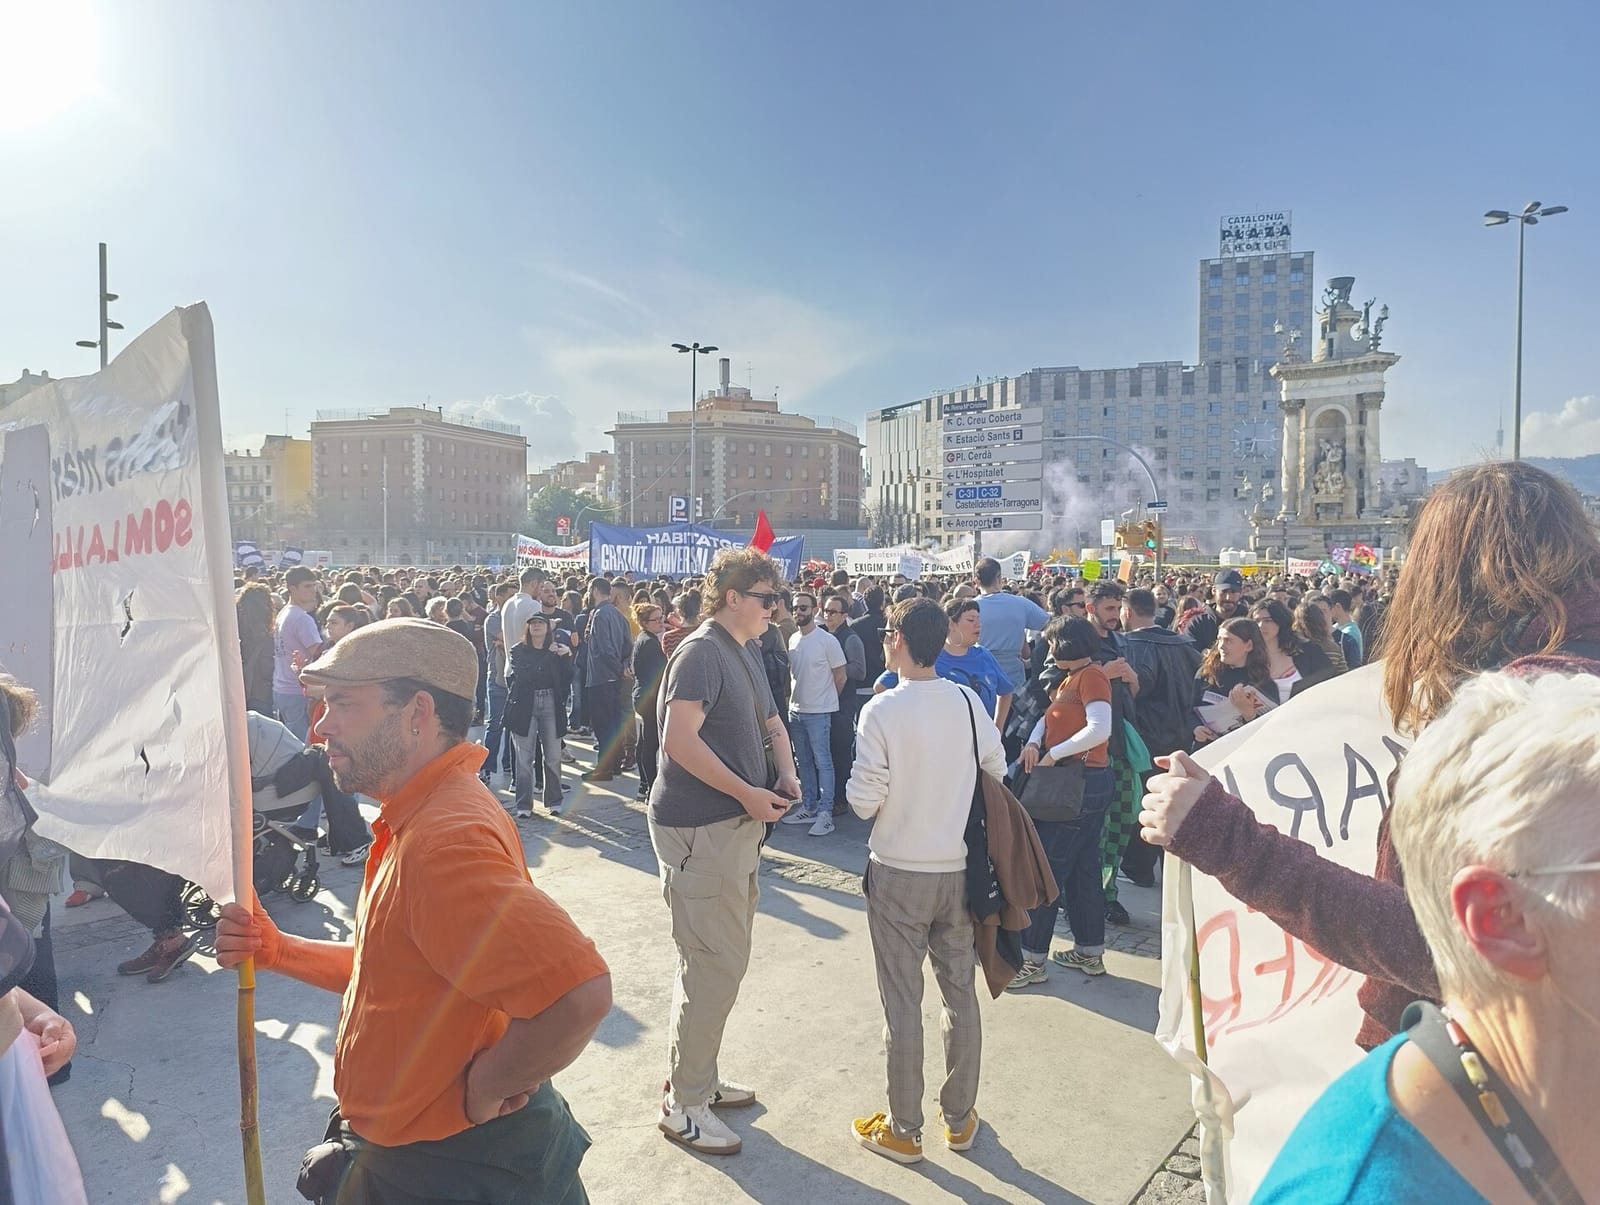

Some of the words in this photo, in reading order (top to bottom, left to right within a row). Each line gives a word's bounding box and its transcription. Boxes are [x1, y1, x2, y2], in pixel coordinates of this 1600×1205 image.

[1228, 213, 1284, 225] CATALONIA
[1221, 225, 1291, 240] PLAZA
[956, 417, 965, 427] C.
[967, 416, 986, 425] Creu
[989, 412, 1022, 424] Coberta
[956, 432, 985, 444] Estació
[987, 431, 1011, 442] Sants
[956, 452, 966, 461] Pl.
[968, 450, 992, 461] Cerdà
[956, 467, 1004, 479] L'Hospitalet
[958, 489, 975, 498] C-31
[981, 487, 999, 497] C-32
[955, 498, 1039, 509] Castelldefels-Tarragona
[956, 518, 990, 529] Aeroport
[647, 532, 745, 551] HABITATGE
[601, 541, 648, 574] GRATUÏT,
[651, 544, 708, 575] UNIVERSAL
[854, 562, 884, 573] EXIGIM
[956, 560, 972, 572] PER
